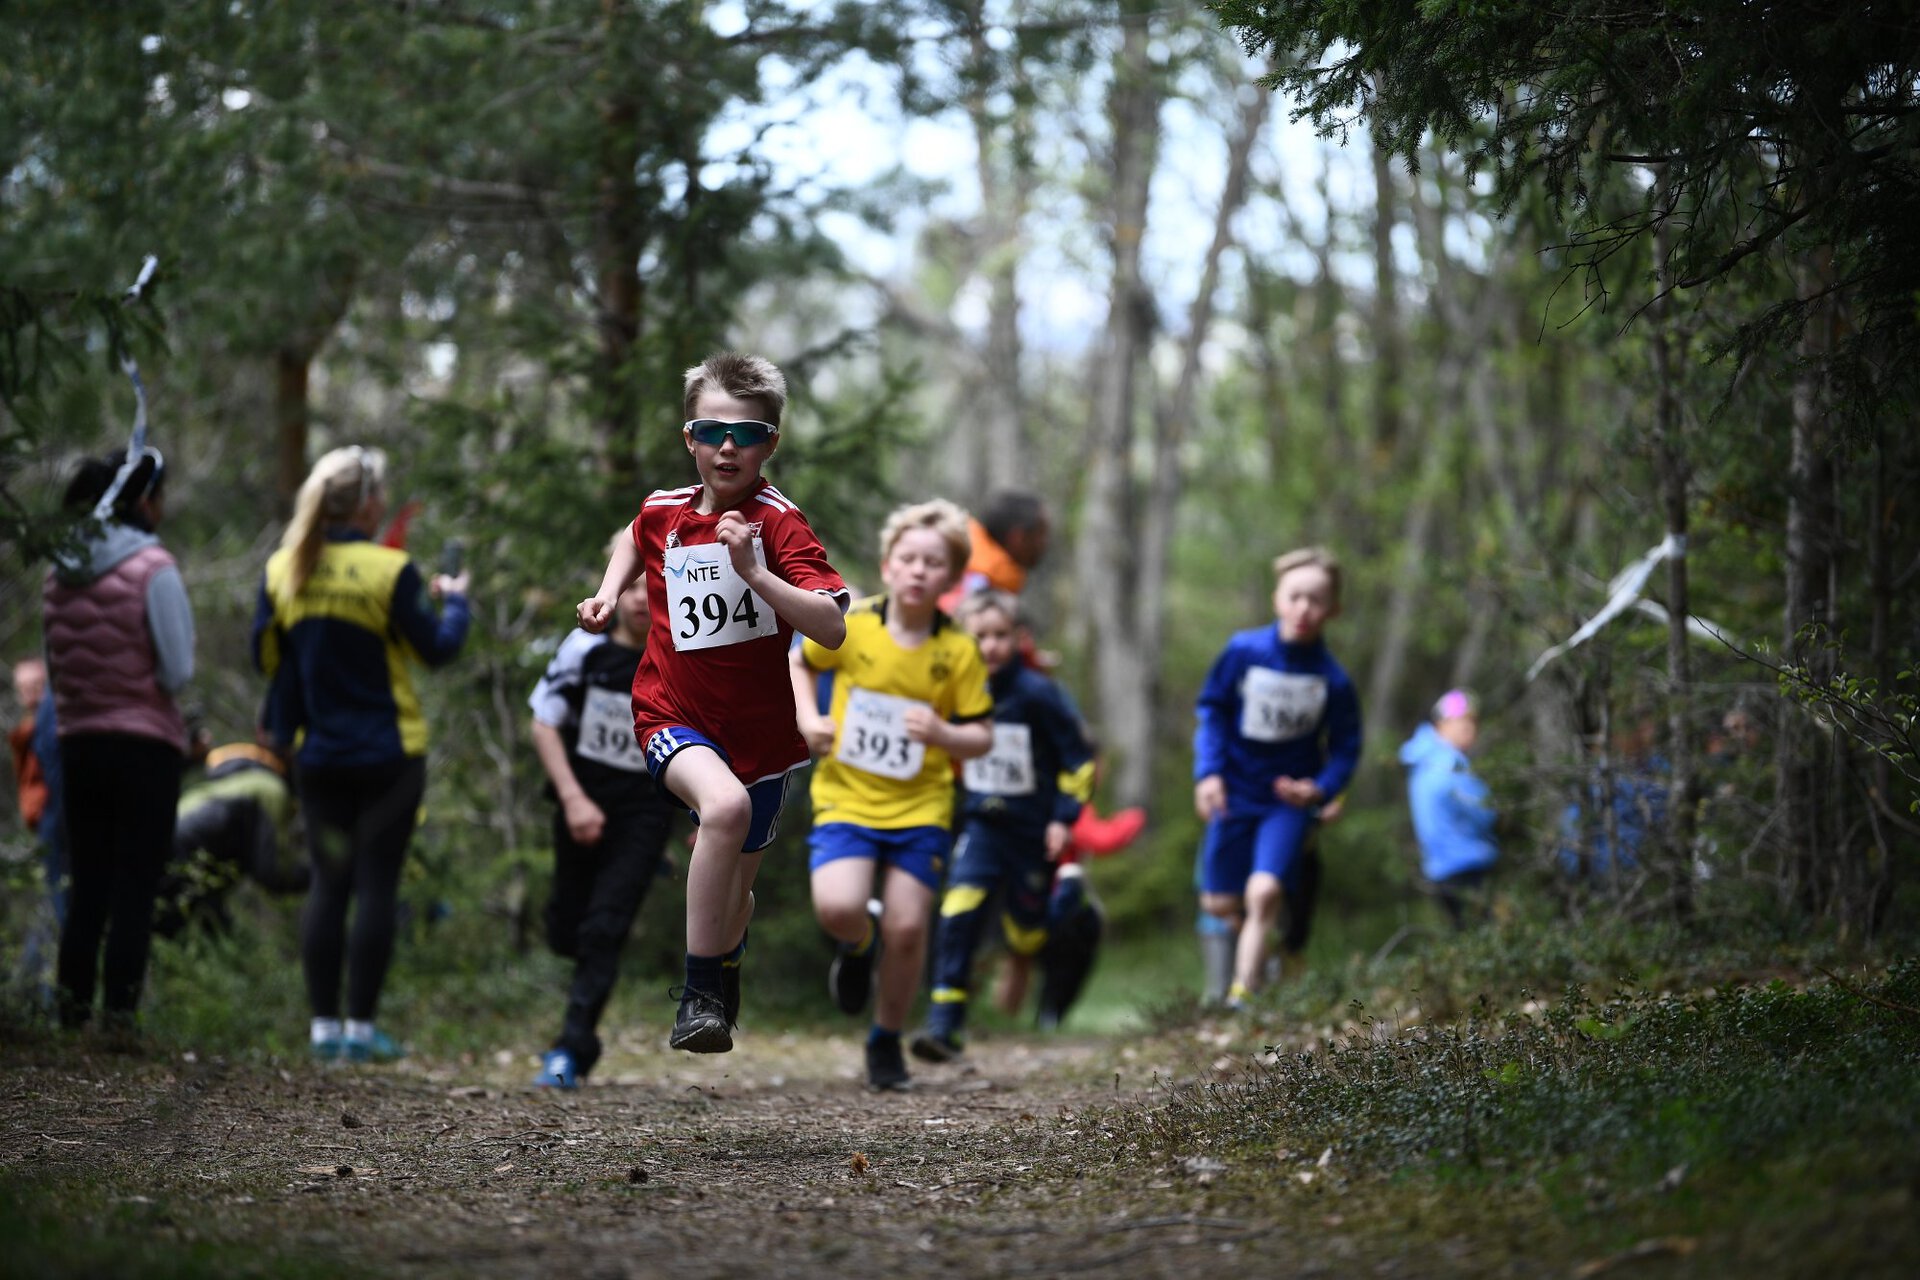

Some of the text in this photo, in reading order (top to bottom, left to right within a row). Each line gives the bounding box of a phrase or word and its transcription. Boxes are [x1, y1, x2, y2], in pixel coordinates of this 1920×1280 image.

[687, 566, 720, 583] NTE
[679, 588, 759, 639] 394
[847, 726, 910, 769] 393
